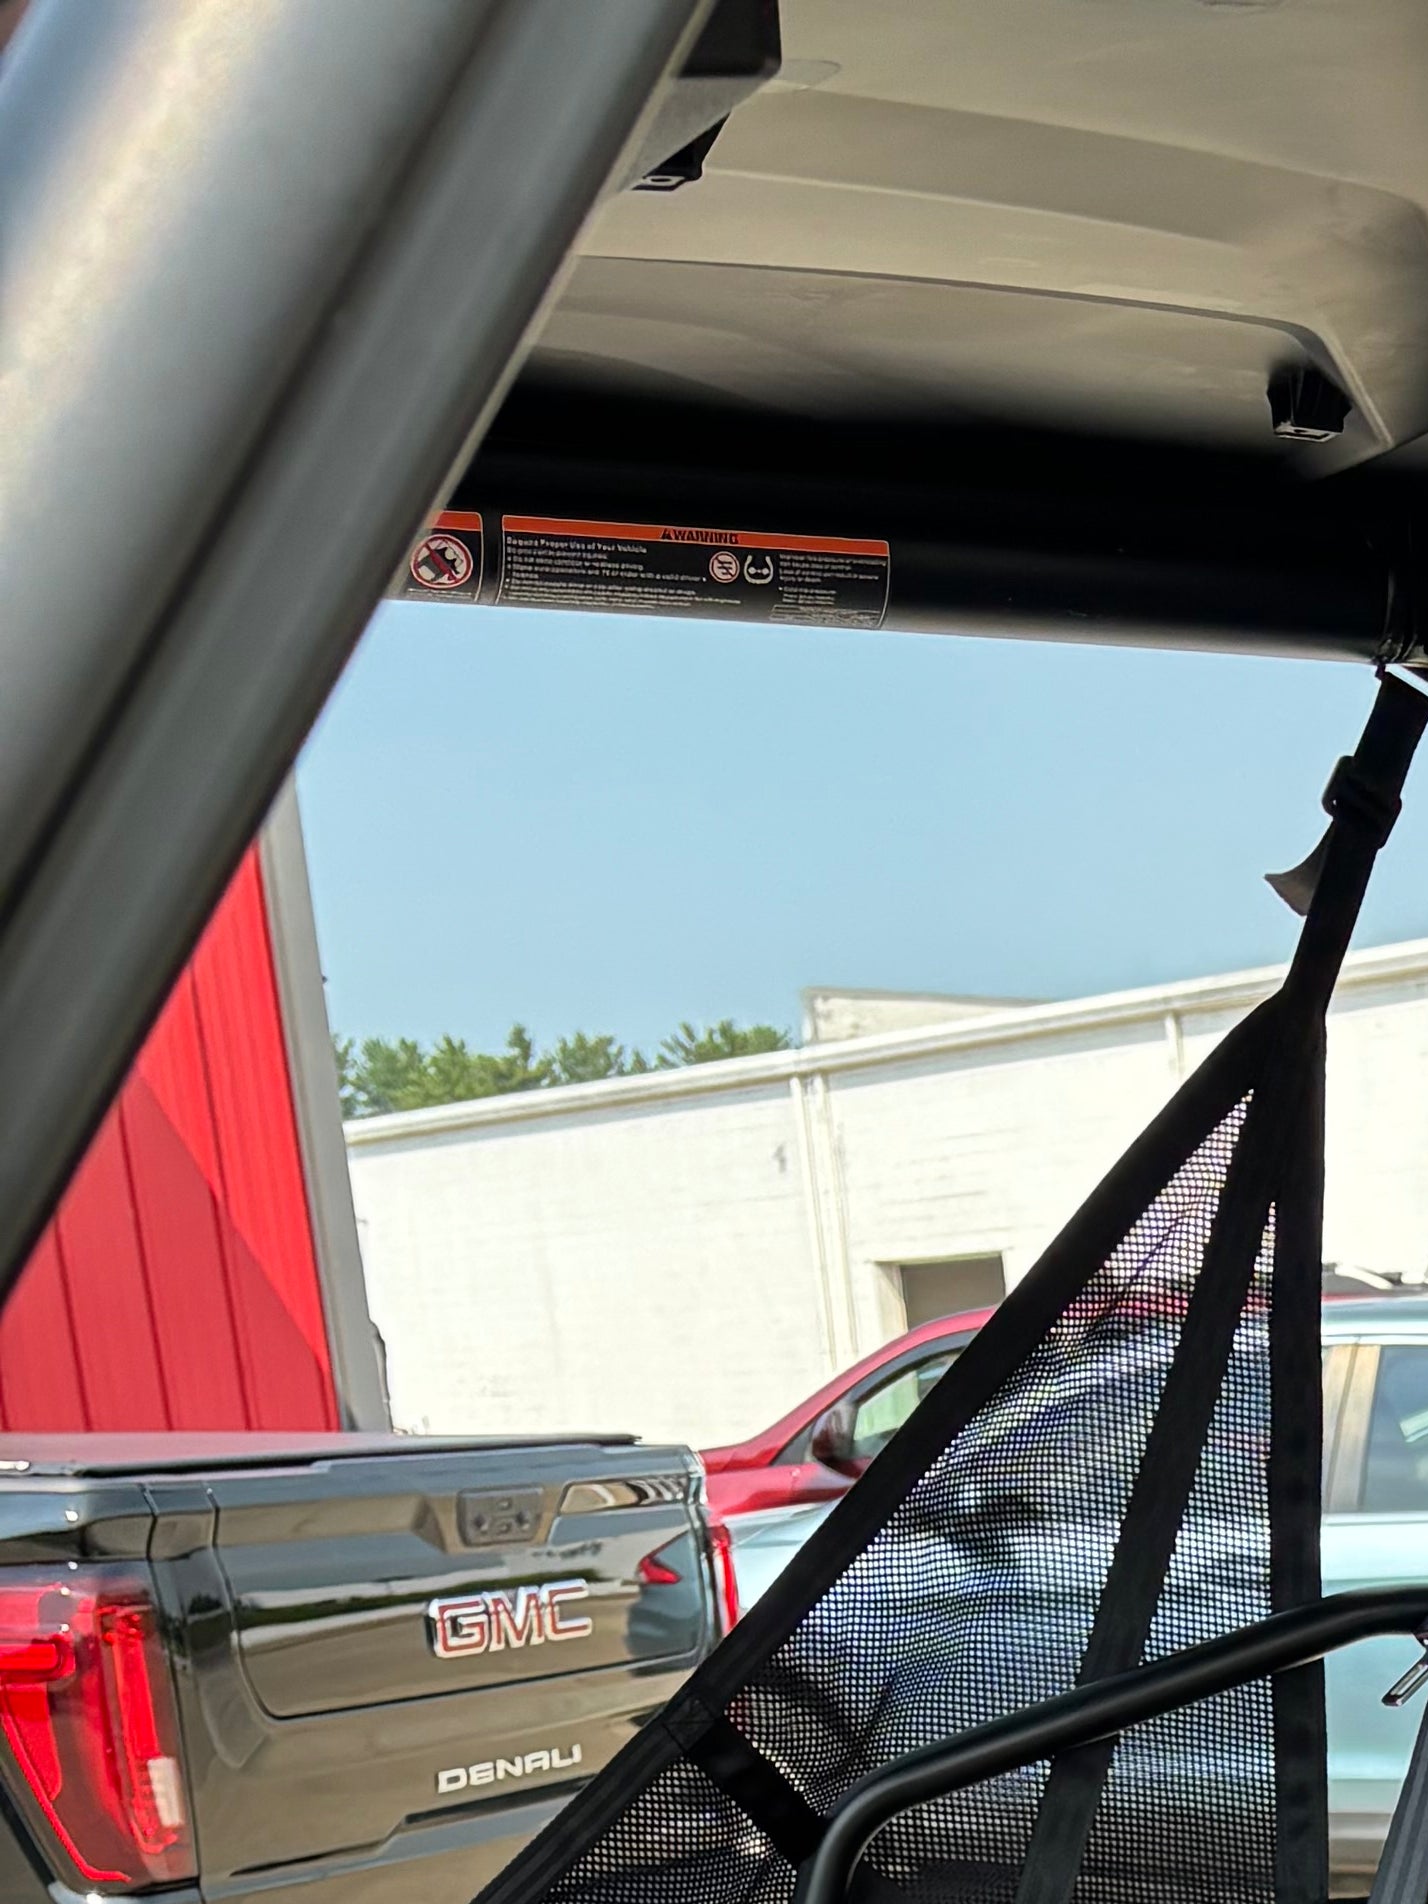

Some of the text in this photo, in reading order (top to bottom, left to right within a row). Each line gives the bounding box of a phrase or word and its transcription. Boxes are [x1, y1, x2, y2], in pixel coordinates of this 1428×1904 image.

[674, 531, 739, 545] WARNING
[427, 1578, 592, 1659] GMC
[437, 1744, 582, 1794] DENALI
